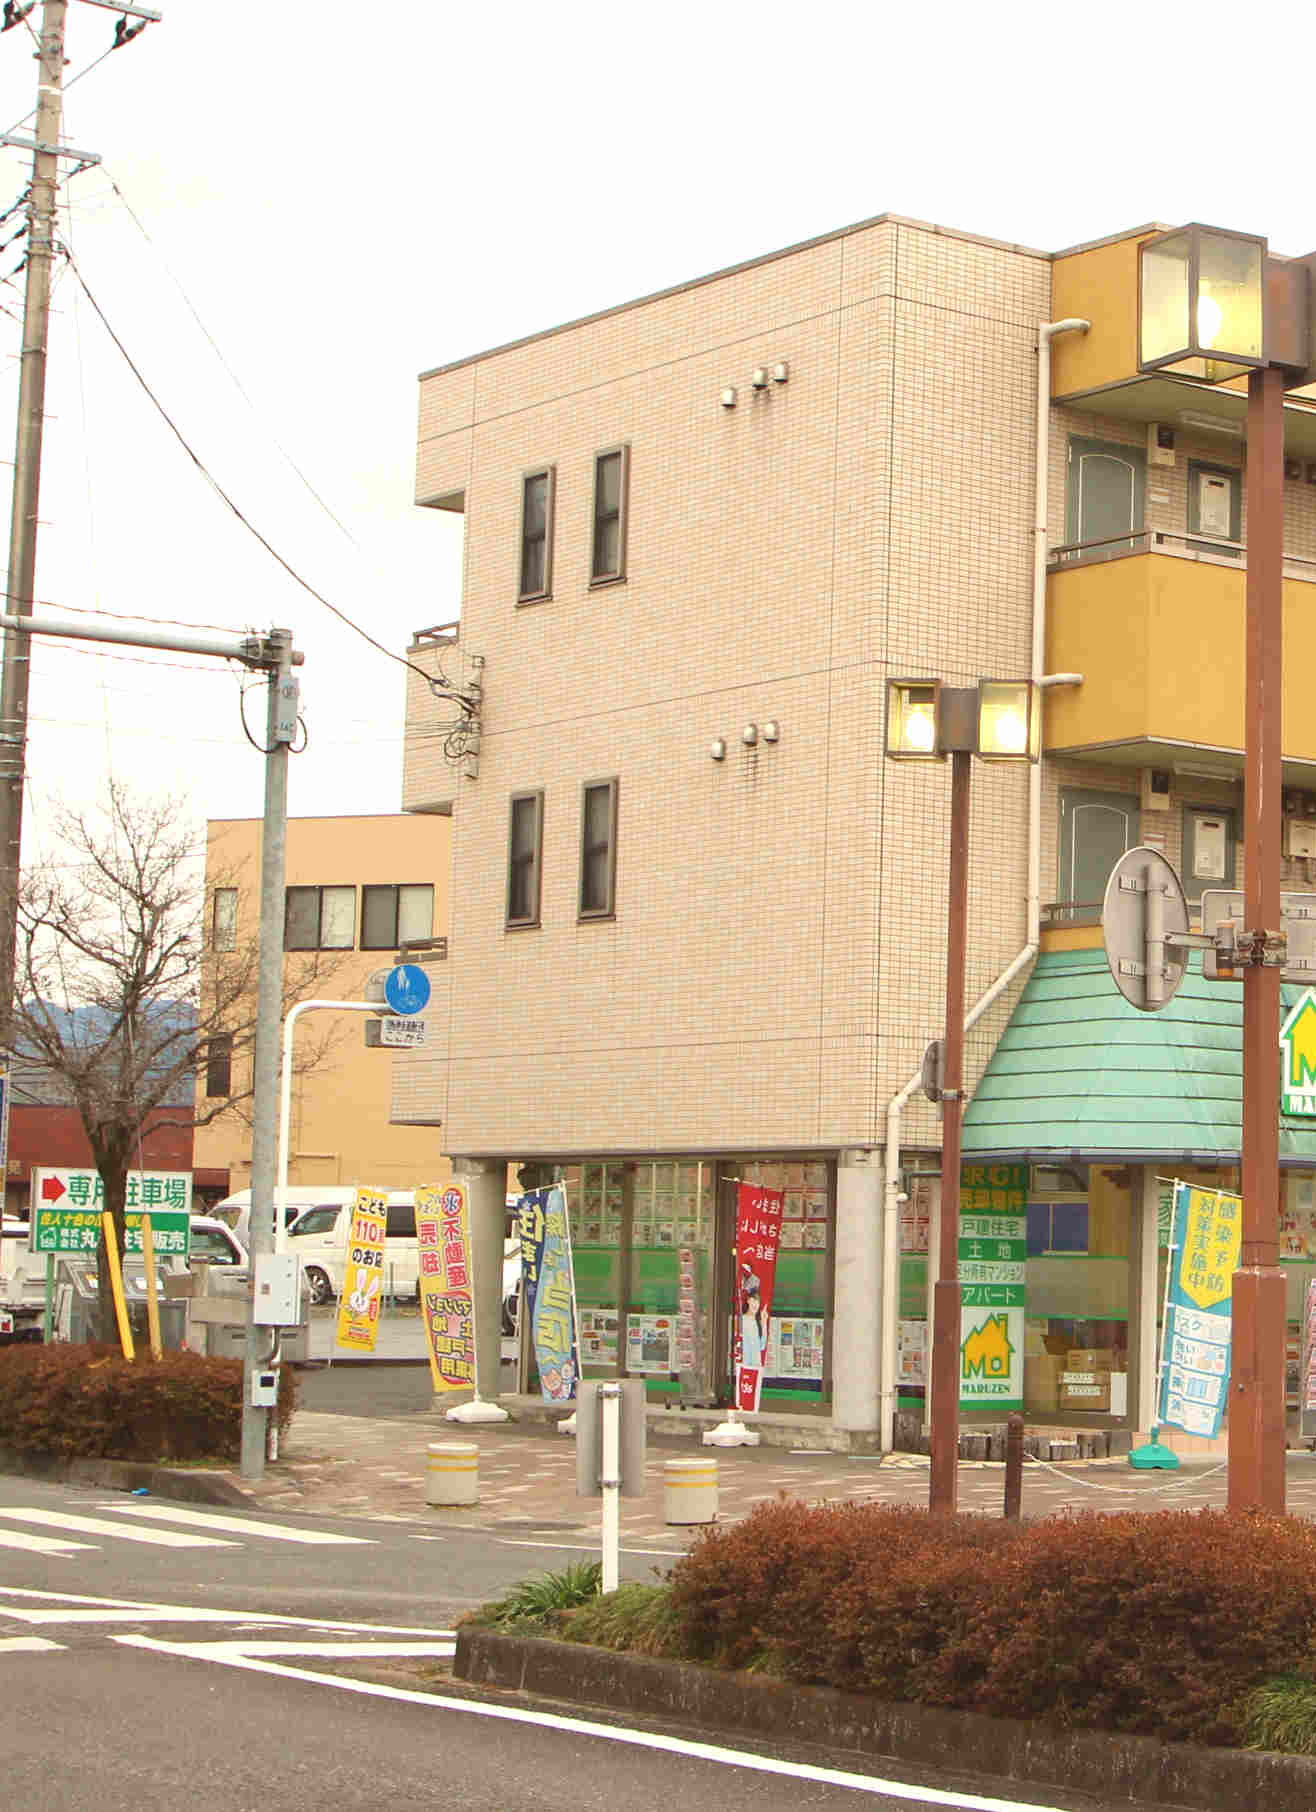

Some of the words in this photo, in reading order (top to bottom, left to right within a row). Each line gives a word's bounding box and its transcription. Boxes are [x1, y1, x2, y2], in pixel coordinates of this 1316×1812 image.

[358, 1196, 385, 1216] こども
[962, 1286, 1017, 1304] アパート
